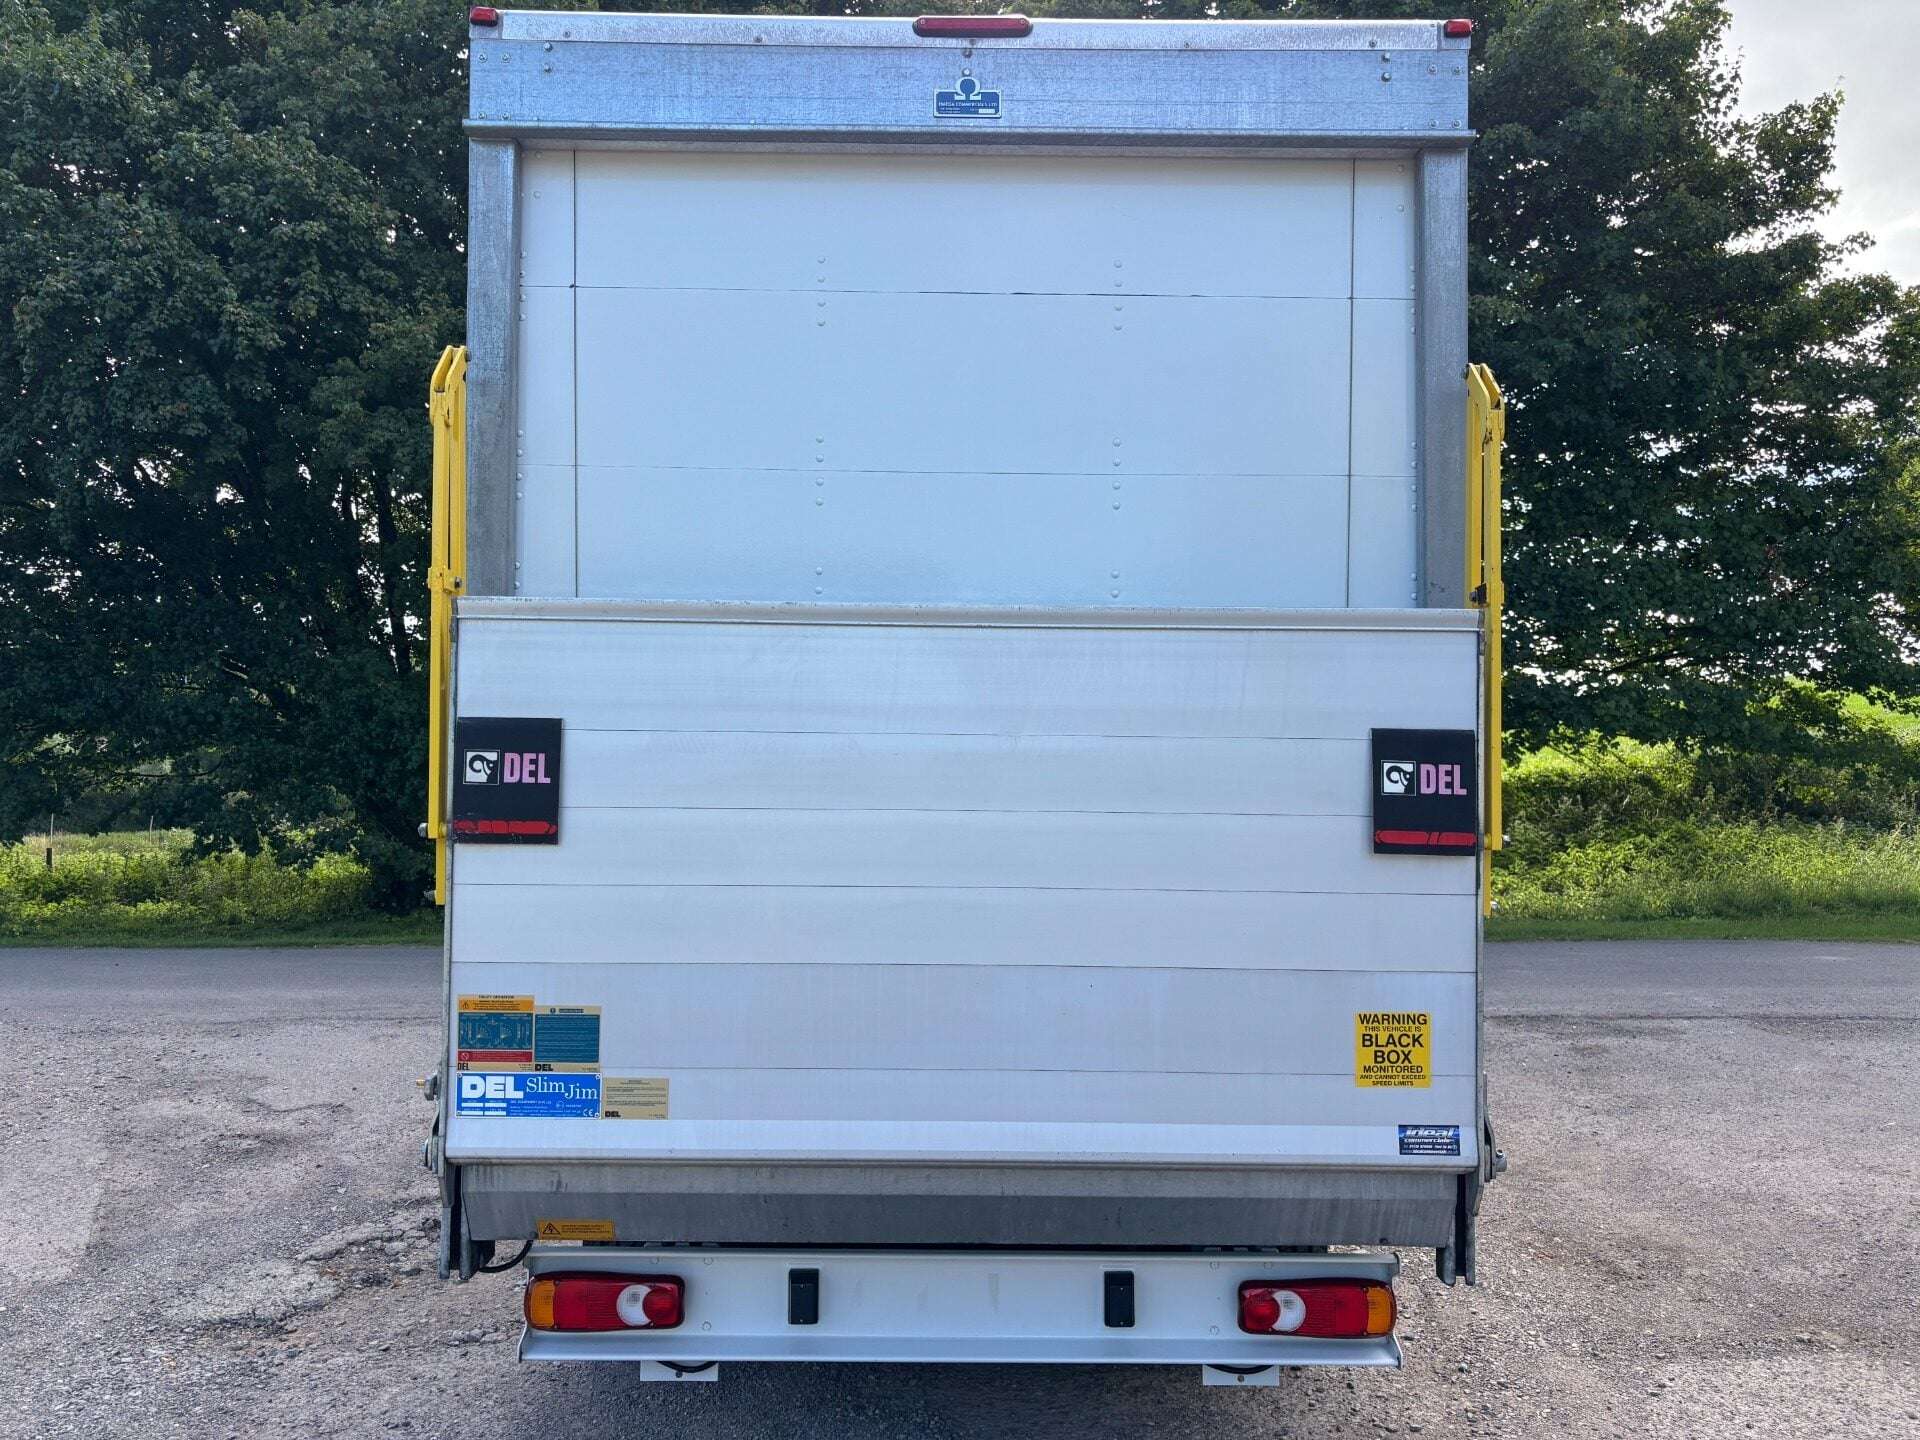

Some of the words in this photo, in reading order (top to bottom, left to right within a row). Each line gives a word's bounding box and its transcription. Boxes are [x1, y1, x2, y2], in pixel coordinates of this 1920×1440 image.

[503, 752, 551, 784] DEL
[1420, 763, 1468, 796] DEL
[1358, 1013, 1428, 1025] WARNING
[1361, 1033, 1425, 1048] BLACK
[1373, 1049, 1413, 1065] BOX
[535, 1063, 554, 1072] DEL
[1363, 1065, 1423, 1074] MONITORED
[461, 1075, 524, 1099] DEL
[526, 1076, 565, 1093] Slim
[564, 1083, 598, 1100] Jim
[604, 1110, 621, 1118] DEL
